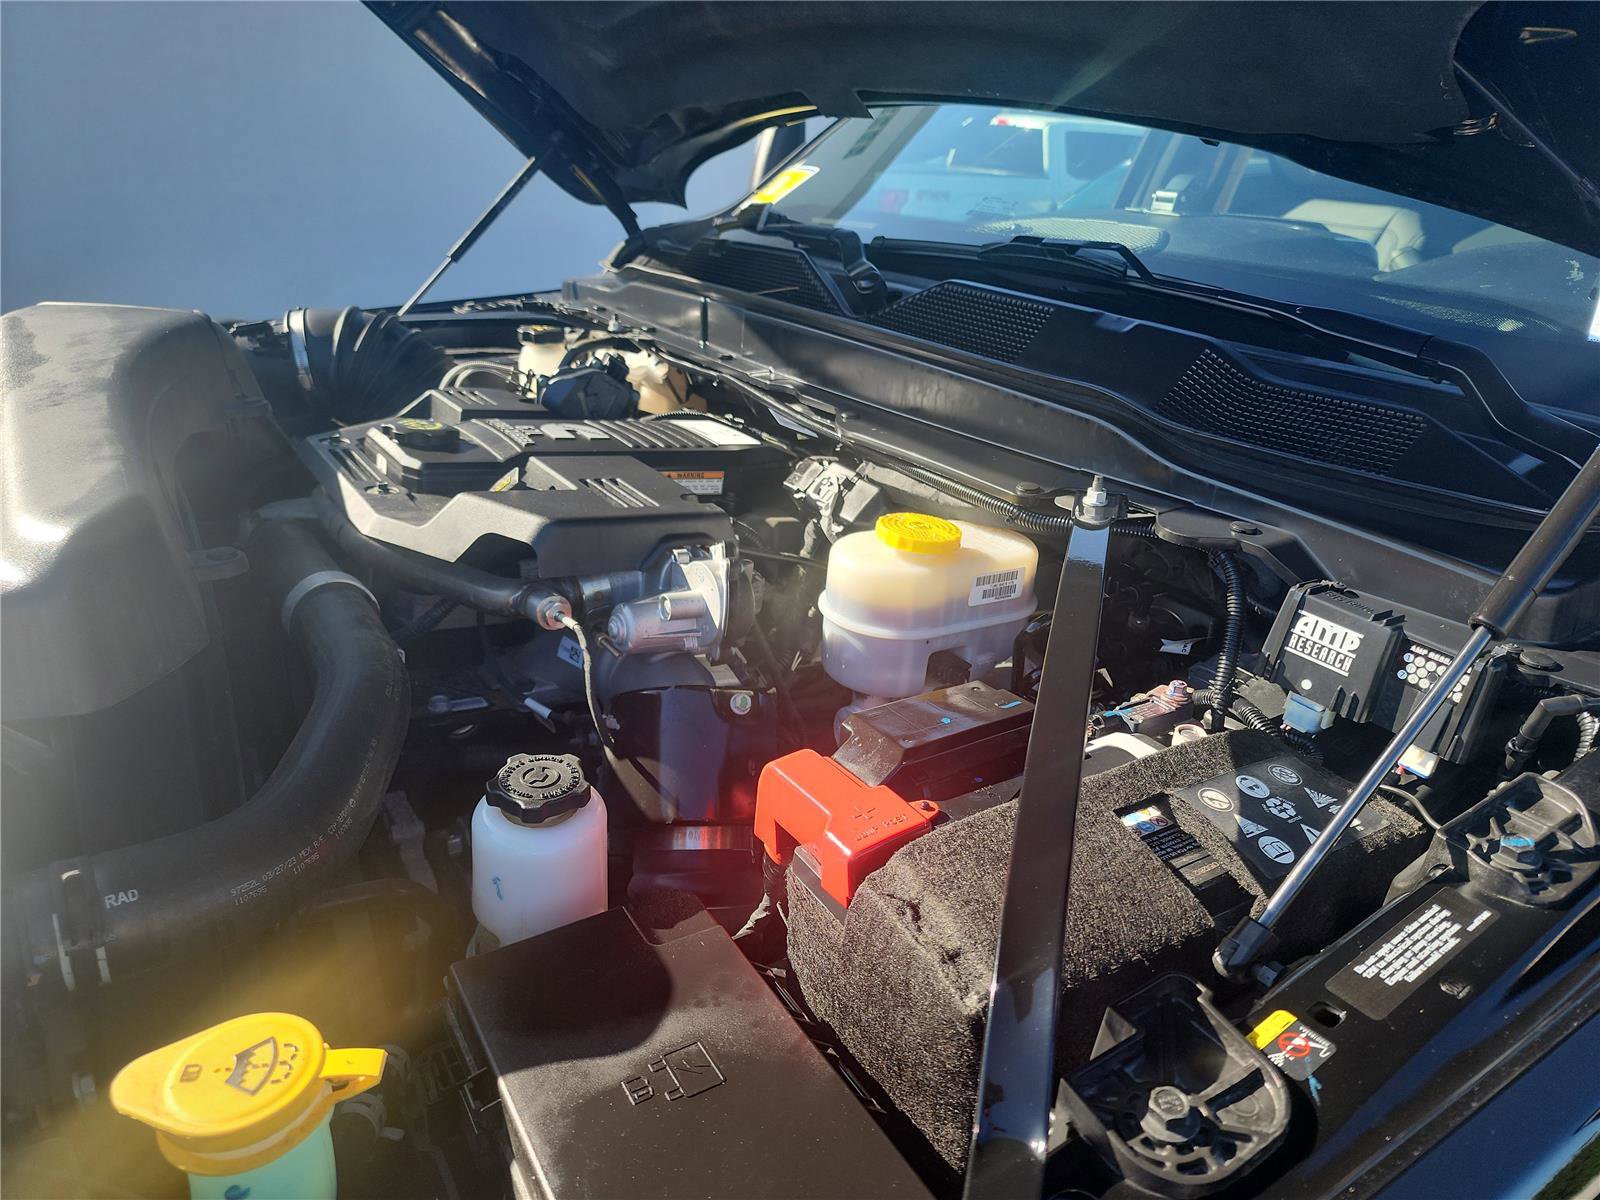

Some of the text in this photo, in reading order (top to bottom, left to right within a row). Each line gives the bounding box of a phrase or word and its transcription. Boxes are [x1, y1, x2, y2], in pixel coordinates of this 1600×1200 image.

[677, 472, 704, 480] WARNING
[1291, 610, 1363, 657] AMP
[1288, 634, 1354, 672] RESEARCH
[855, 826, 879, 841] JUMP
[262, 856, 297, 882] 03/27/23
[104, 889, 139, 909] RAD
